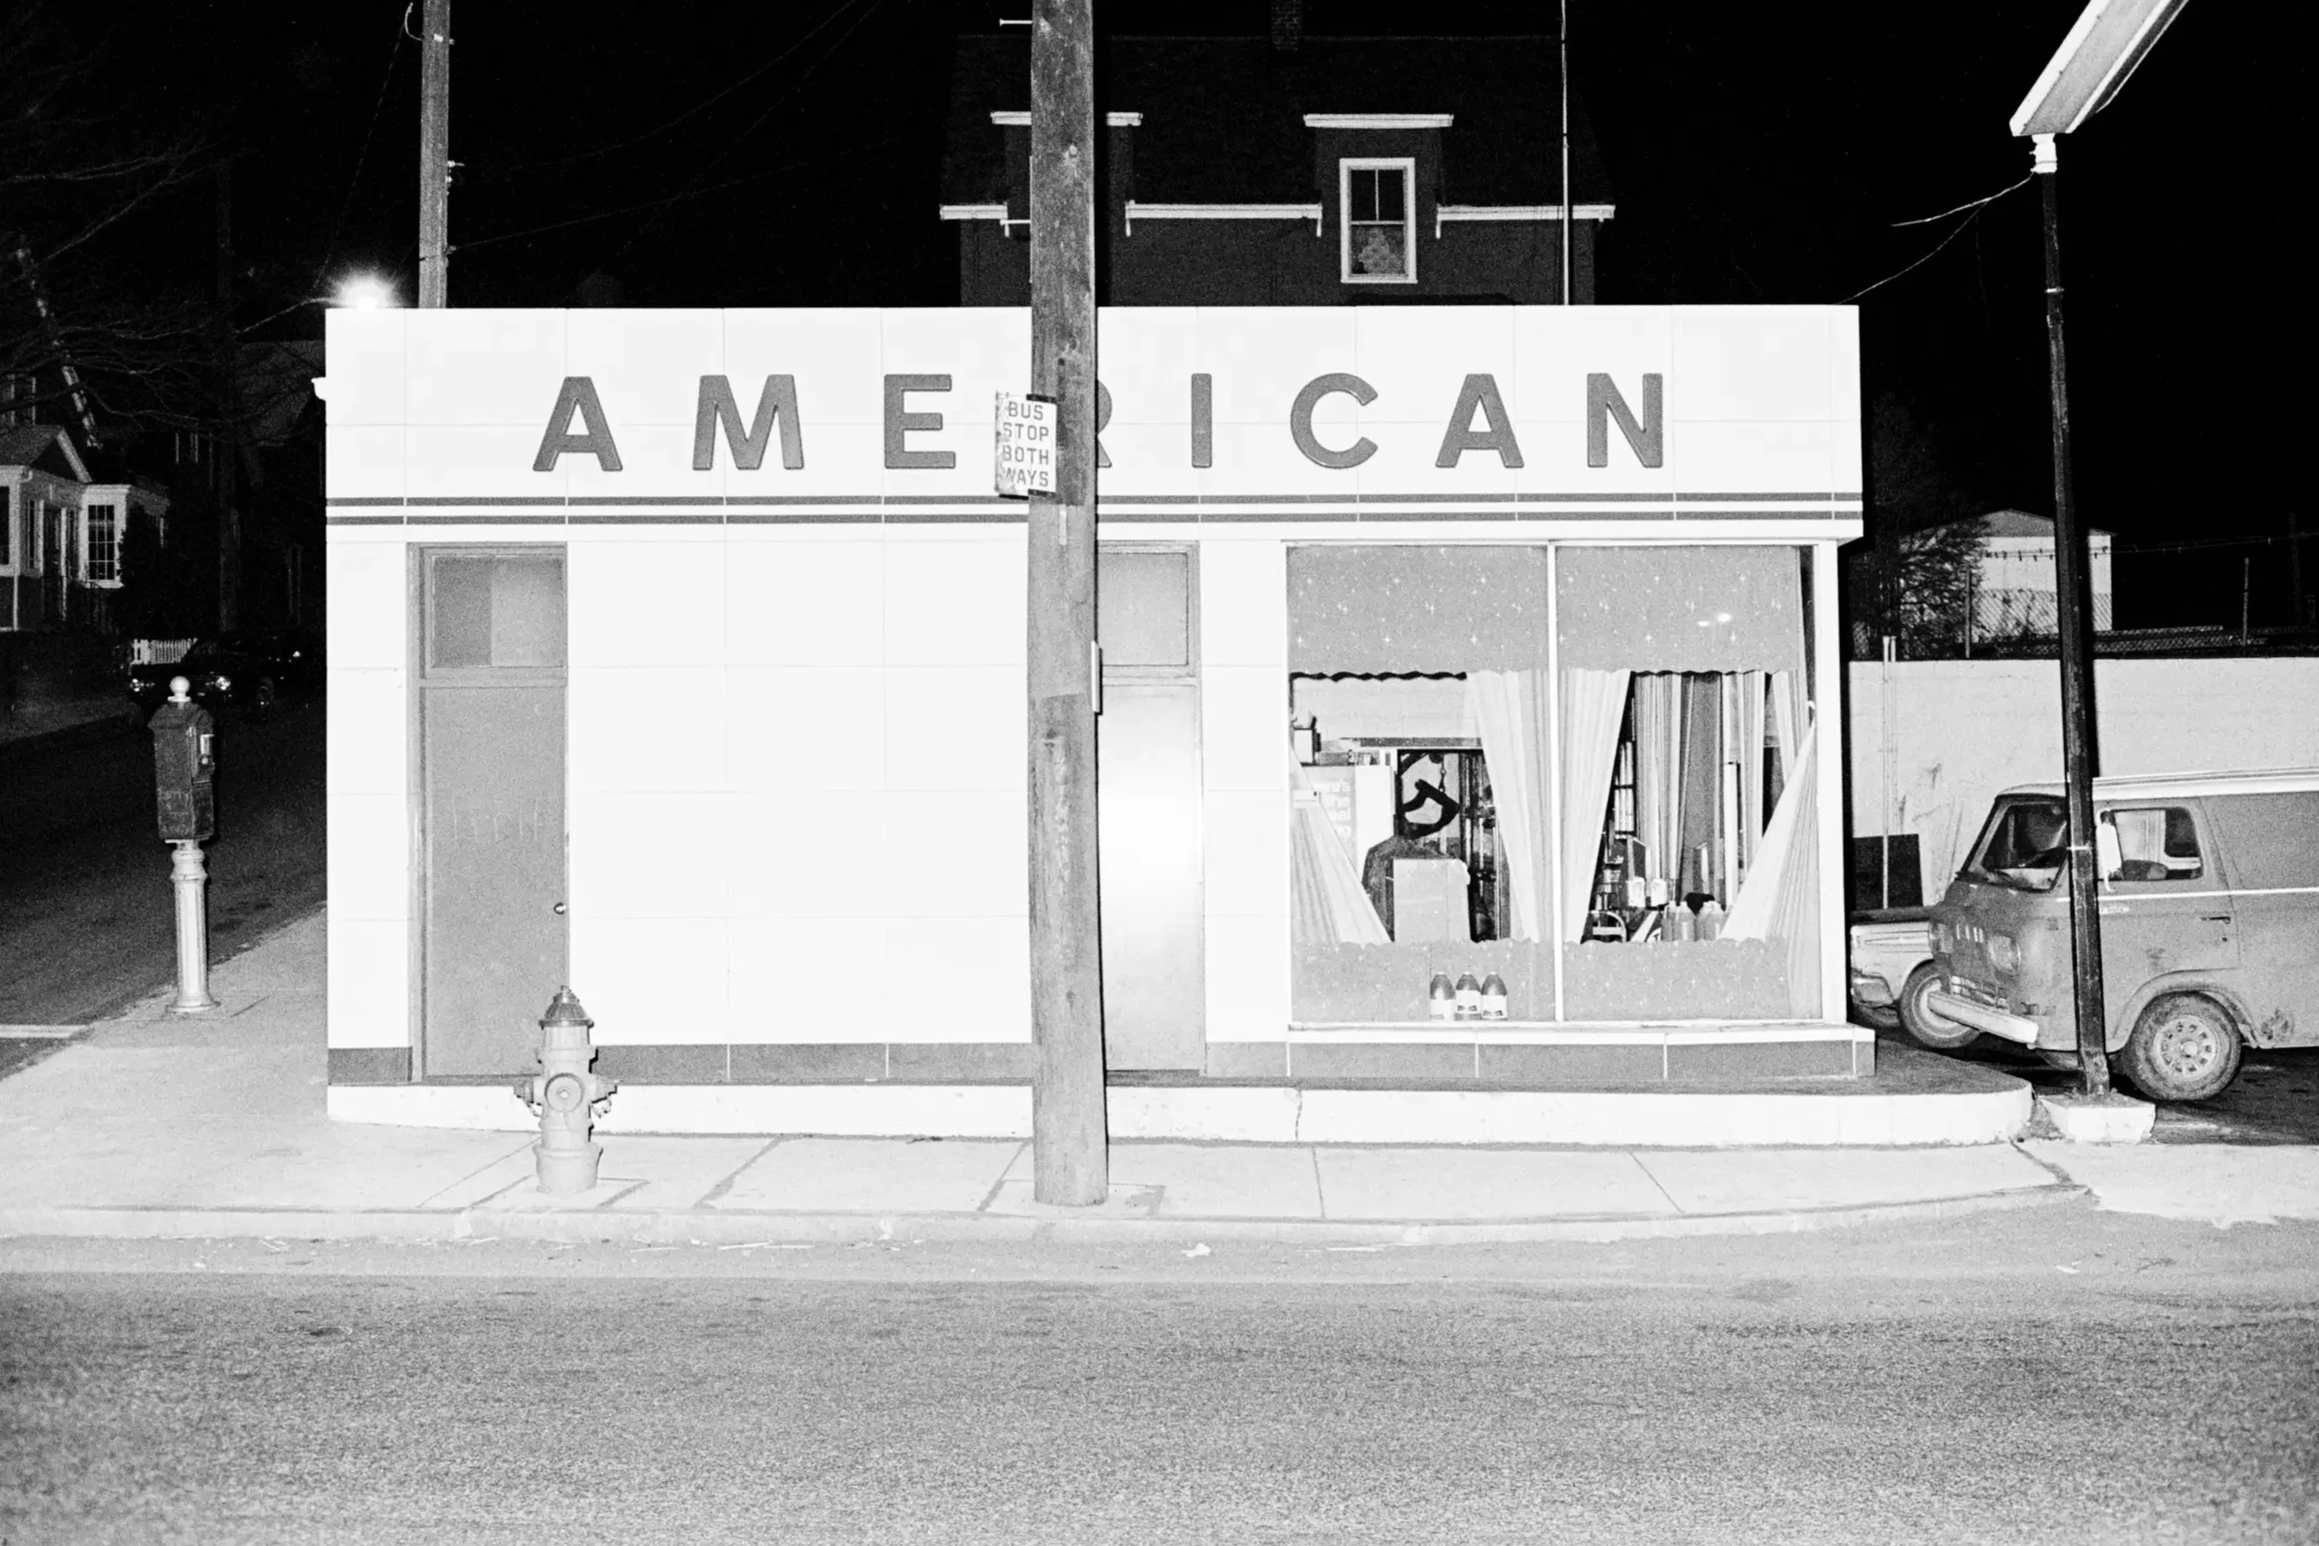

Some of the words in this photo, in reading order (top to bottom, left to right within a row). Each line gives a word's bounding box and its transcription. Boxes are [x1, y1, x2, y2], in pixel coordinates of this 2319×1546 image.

[1008, 401, 1044, 421] BUS
[533, 373, 1663, 471] AMEICAN
[1002, 422, 1049, 441] STOP
[1002, 445, 1049, 465] BOTH
